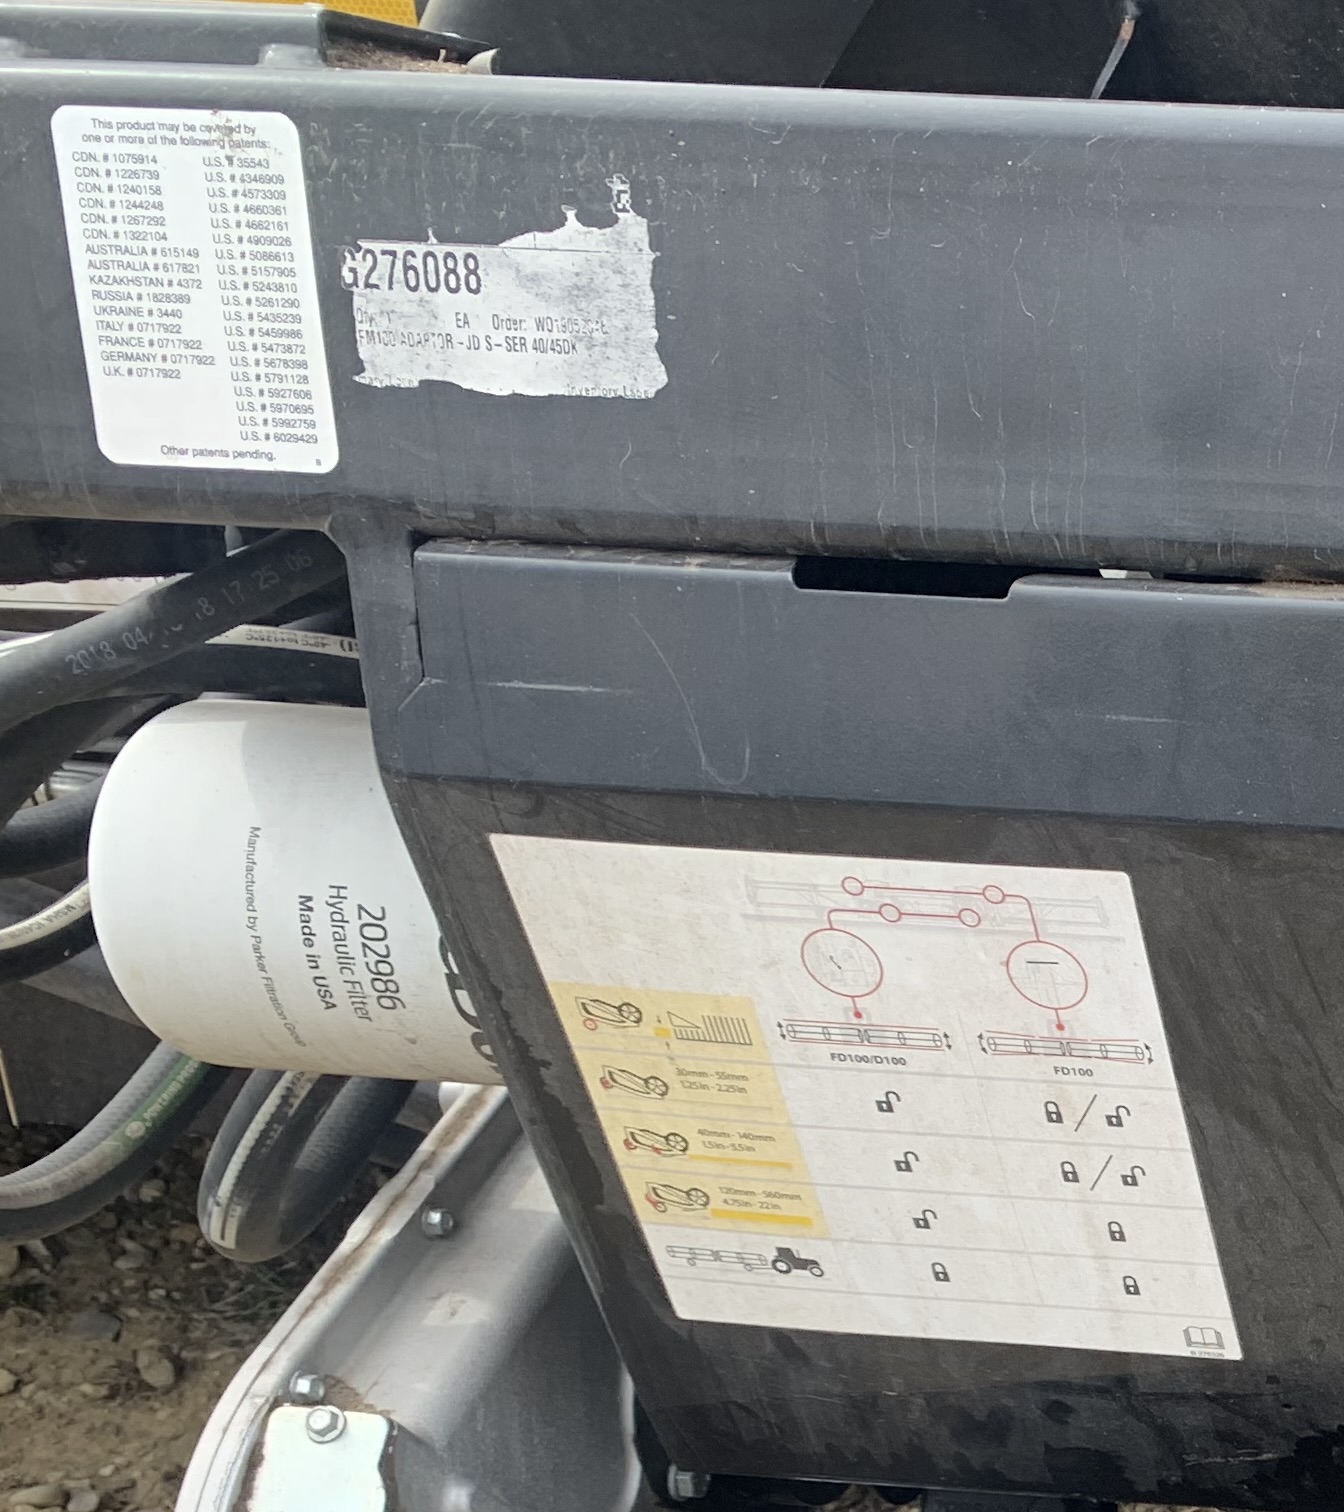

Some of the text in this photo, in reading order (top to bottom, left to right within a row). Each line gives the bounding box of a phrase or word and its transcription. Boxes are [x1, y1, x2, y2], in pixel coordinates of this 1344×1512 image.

[91, 118, 113, 129] This
[116, 120, 155, 131] product
[157, 121, 179, 134] may
[182, 121, 196, 132] be
[243, 124, 256, 136] by
[81, 134, 101, 143] one
[104, 135, 114, 144] or
[118, 135, 145, 145] more
[147, 134, 157, 145] of
[160, 135, 177, 146] the
[179, 135, 226, 149] following
[72, 151, 100, 162] CDN.
[112, 153, 158, 164] 1075914
[74, 166, 102, 178] CDN.
[114, 168, 160, 180] 1226739
[77, 182, 104, 193] CDN.
[207, 187, 229, 198] U.S.
[79, 197, 106, 209] CDN.
[81, 213, 109, 224] CDN.
[83, 228, 110, 239] CDN.
[85, 243, 149, 256] AUSTRALIA
[88, 259, 151, 272] AUSTRALIA
[89, 275, 164, 288] KAZAKHSTAN
[93, 305, 145, 317] UKRAINE
[96, 320, 124, 331] ITALY
[98, 335, 145, 348] FRANCE
[100, 350, 157, 362] GERMANY
[160, 444, 277, 462] Other patents pending.
[243, 826, 307, 1048] Manufactured by Parker Filtration Group
[299, 895, 337, 1011] Made in USA
[325, 884, 372, 1022] Hydraulic Filter
[357, 904, 406, 1010] 202986
[830, 1052, 907, 1066] FD100/D100
[1053, 1066, 1094, 1078] FD100
